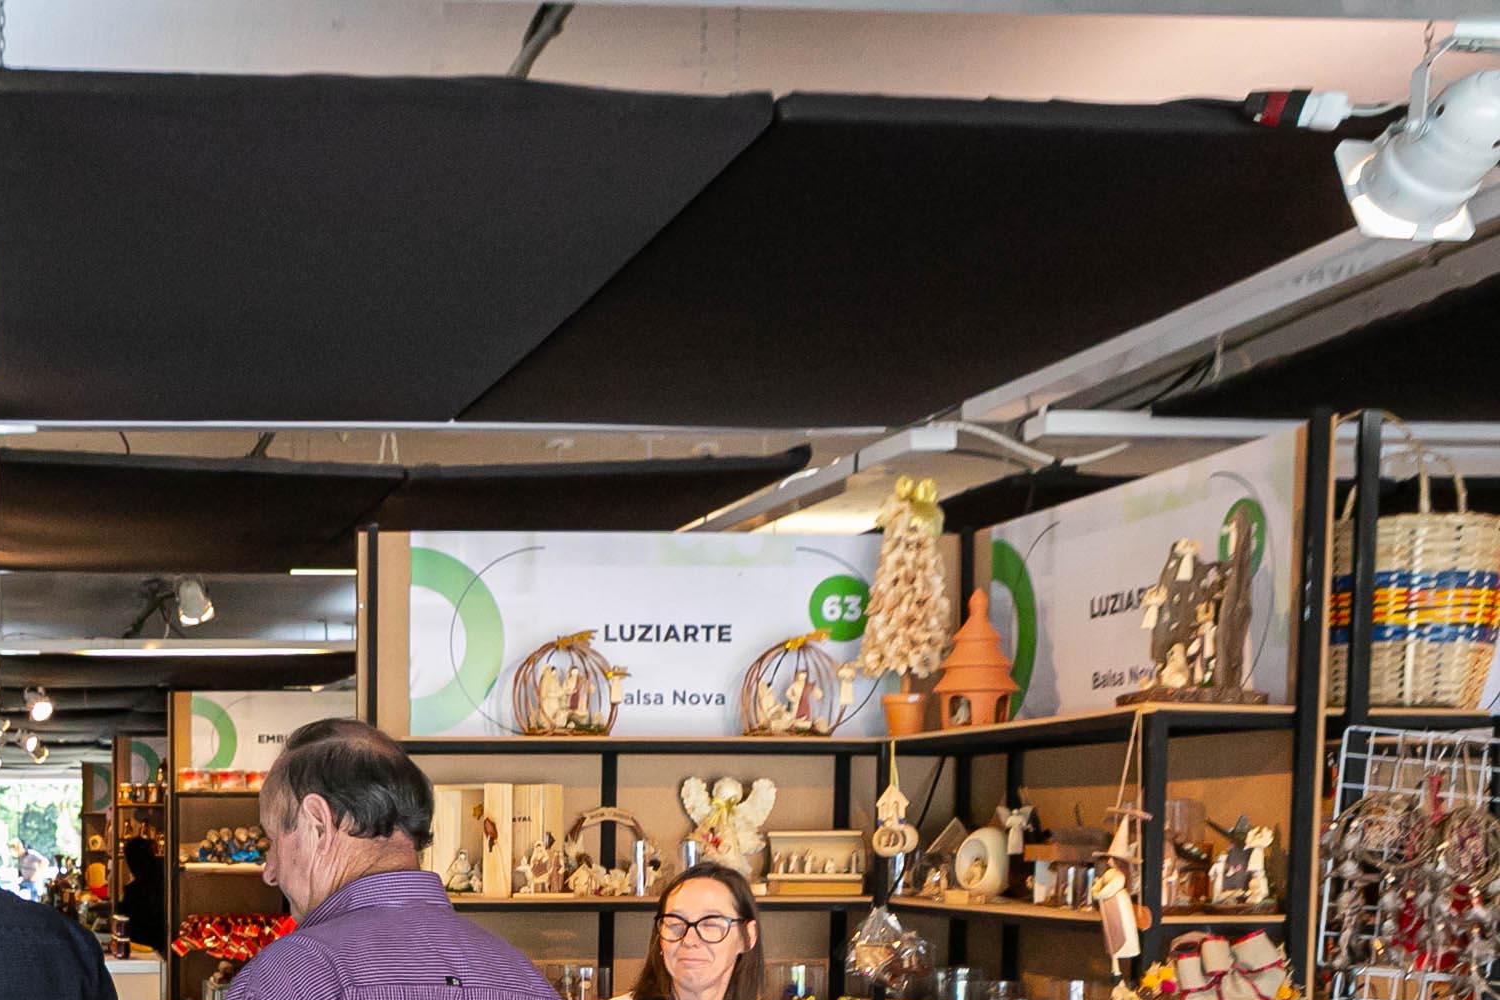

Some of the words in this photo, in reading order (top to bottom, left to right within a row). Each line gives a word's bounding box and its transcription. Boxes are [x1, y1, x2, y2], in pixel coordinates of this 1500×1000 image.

[822, 594, 862, 622] 63
[604, 624, 732, 642] LUZIARTE
[623, 689, 664, 705] alsa
[673, 690, 725, 705] Nova
